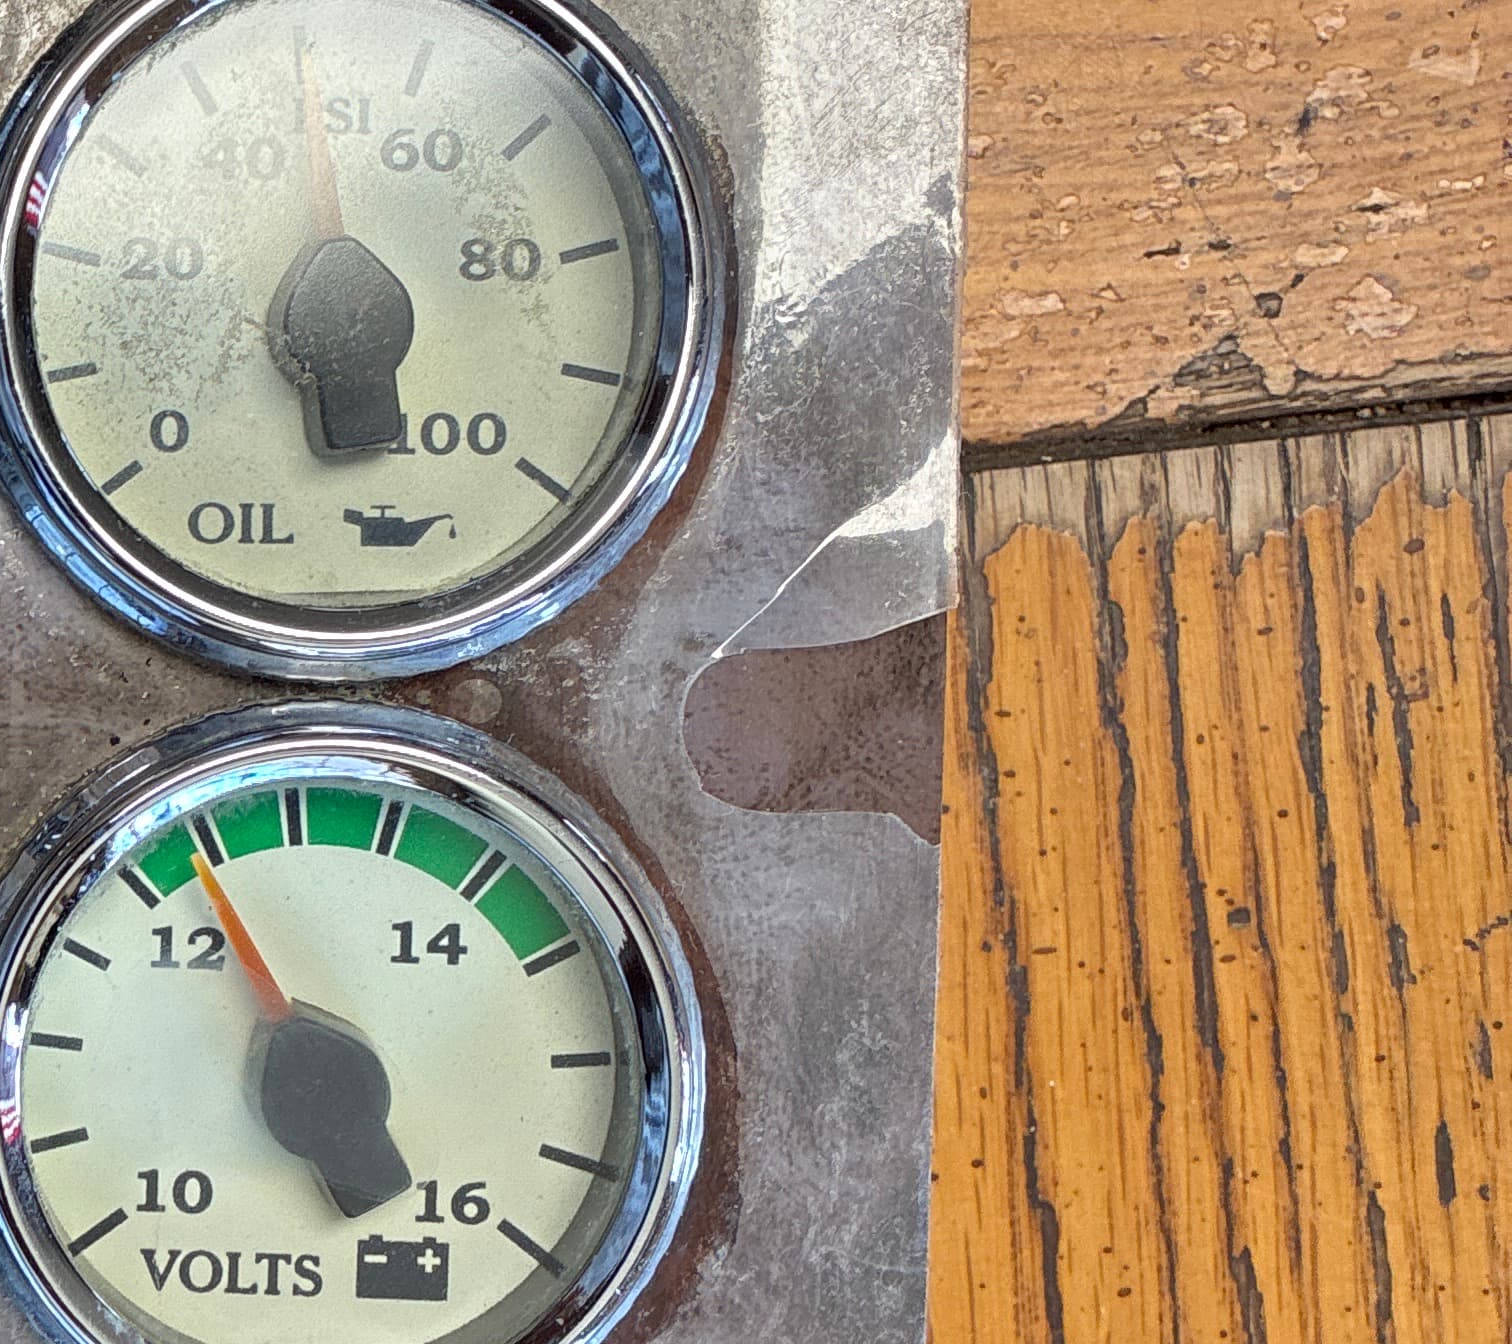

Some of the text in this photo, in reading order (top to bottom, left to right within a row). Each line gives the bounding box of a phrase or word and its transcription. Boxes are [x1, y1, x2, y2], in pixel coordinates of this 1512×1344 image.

[380, 129, 464, 173] 60
[118, 236, 205, 282] 20
[458, 238, 542, 283] 80
[148, 410, 189, 454] 0
[386, 412, 507, 456] 100
[187, 501, 295, 546] OIL
[150, 925, 226, 971] 12
[389, 922, 468, 967] 14
[134, 1169, 214, 1215] 10
[414, 1182, 492, 1225] 16
[139, 1247, 325, 1298] VOLTS
